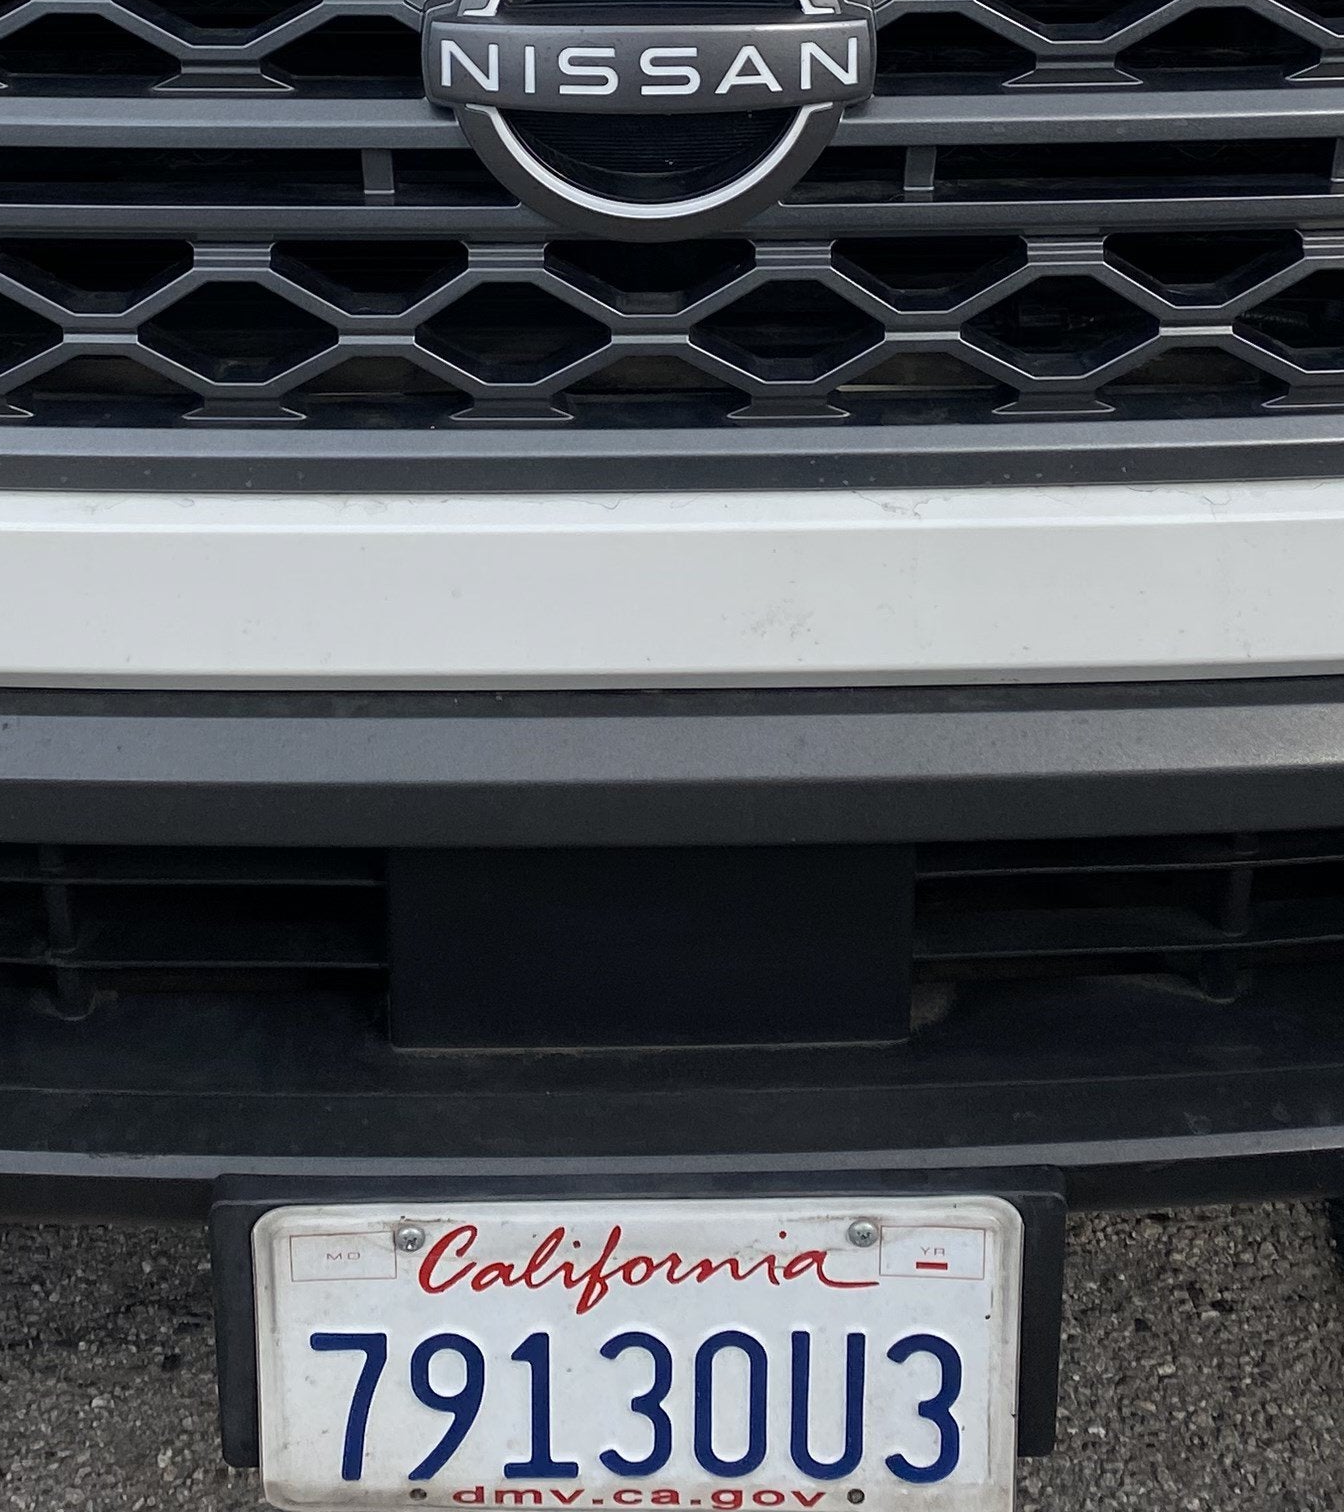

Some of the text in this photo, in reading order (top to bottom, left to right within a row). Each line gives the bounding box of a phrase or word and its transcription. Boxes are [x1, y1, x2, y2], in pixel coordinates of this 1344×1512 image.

[440, 37, 858, 95] NISSAN
[418, 1224, 881, 1315] California
[309, 1329, 963, 1483] 79130U3
[451, 1486, 827, 1510] dmv.ca.gov
